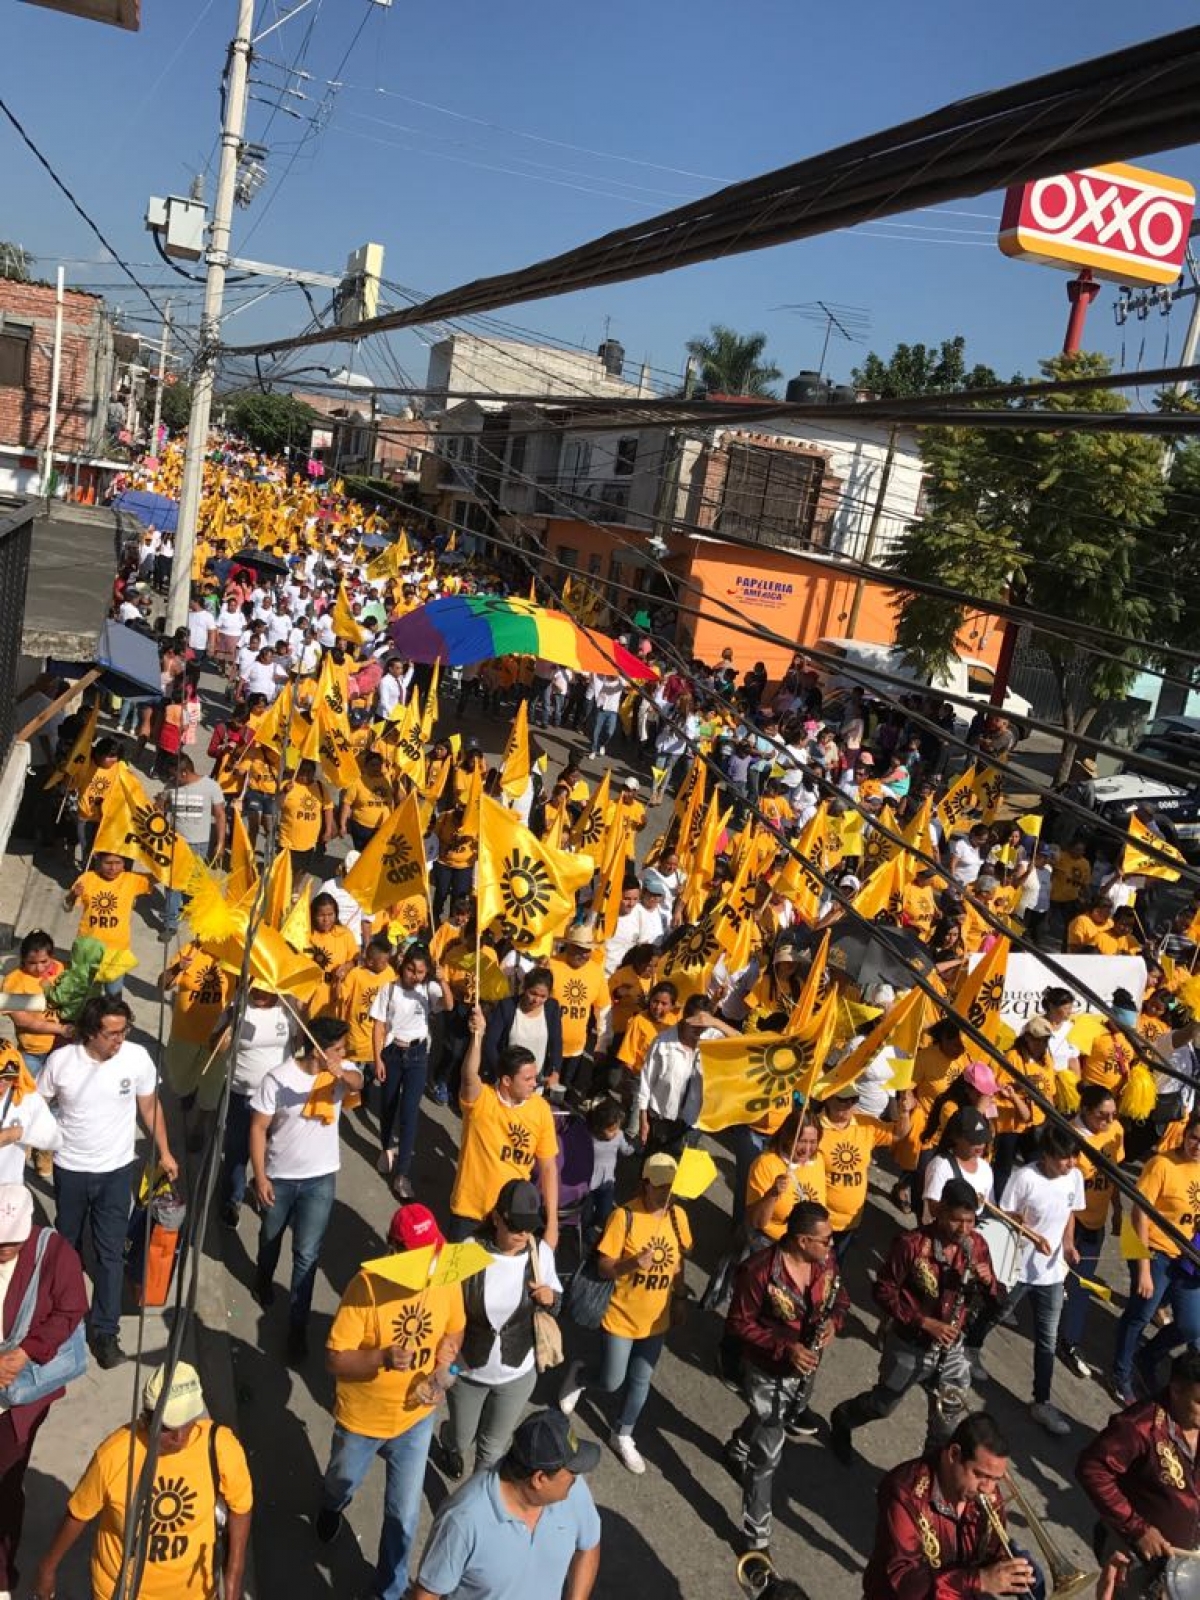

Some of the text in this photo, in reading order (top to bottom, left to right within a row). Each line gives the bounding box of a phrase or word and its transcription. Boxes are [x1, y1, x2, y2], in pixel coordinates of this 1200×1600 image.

[1031, 175, 1183, 257] OXXO
[89, 916, 119, 929] PRD
[189, 990, 222, 1004] PRD
[1003, 988, 1045, 1001] nuev
[560, 1006, 586, 1020] PRD
[830, 1172, 862, 1187] PRD
[632, 1272, 669, 1291] PRD
[148, 1535, 188, 1562] RD
